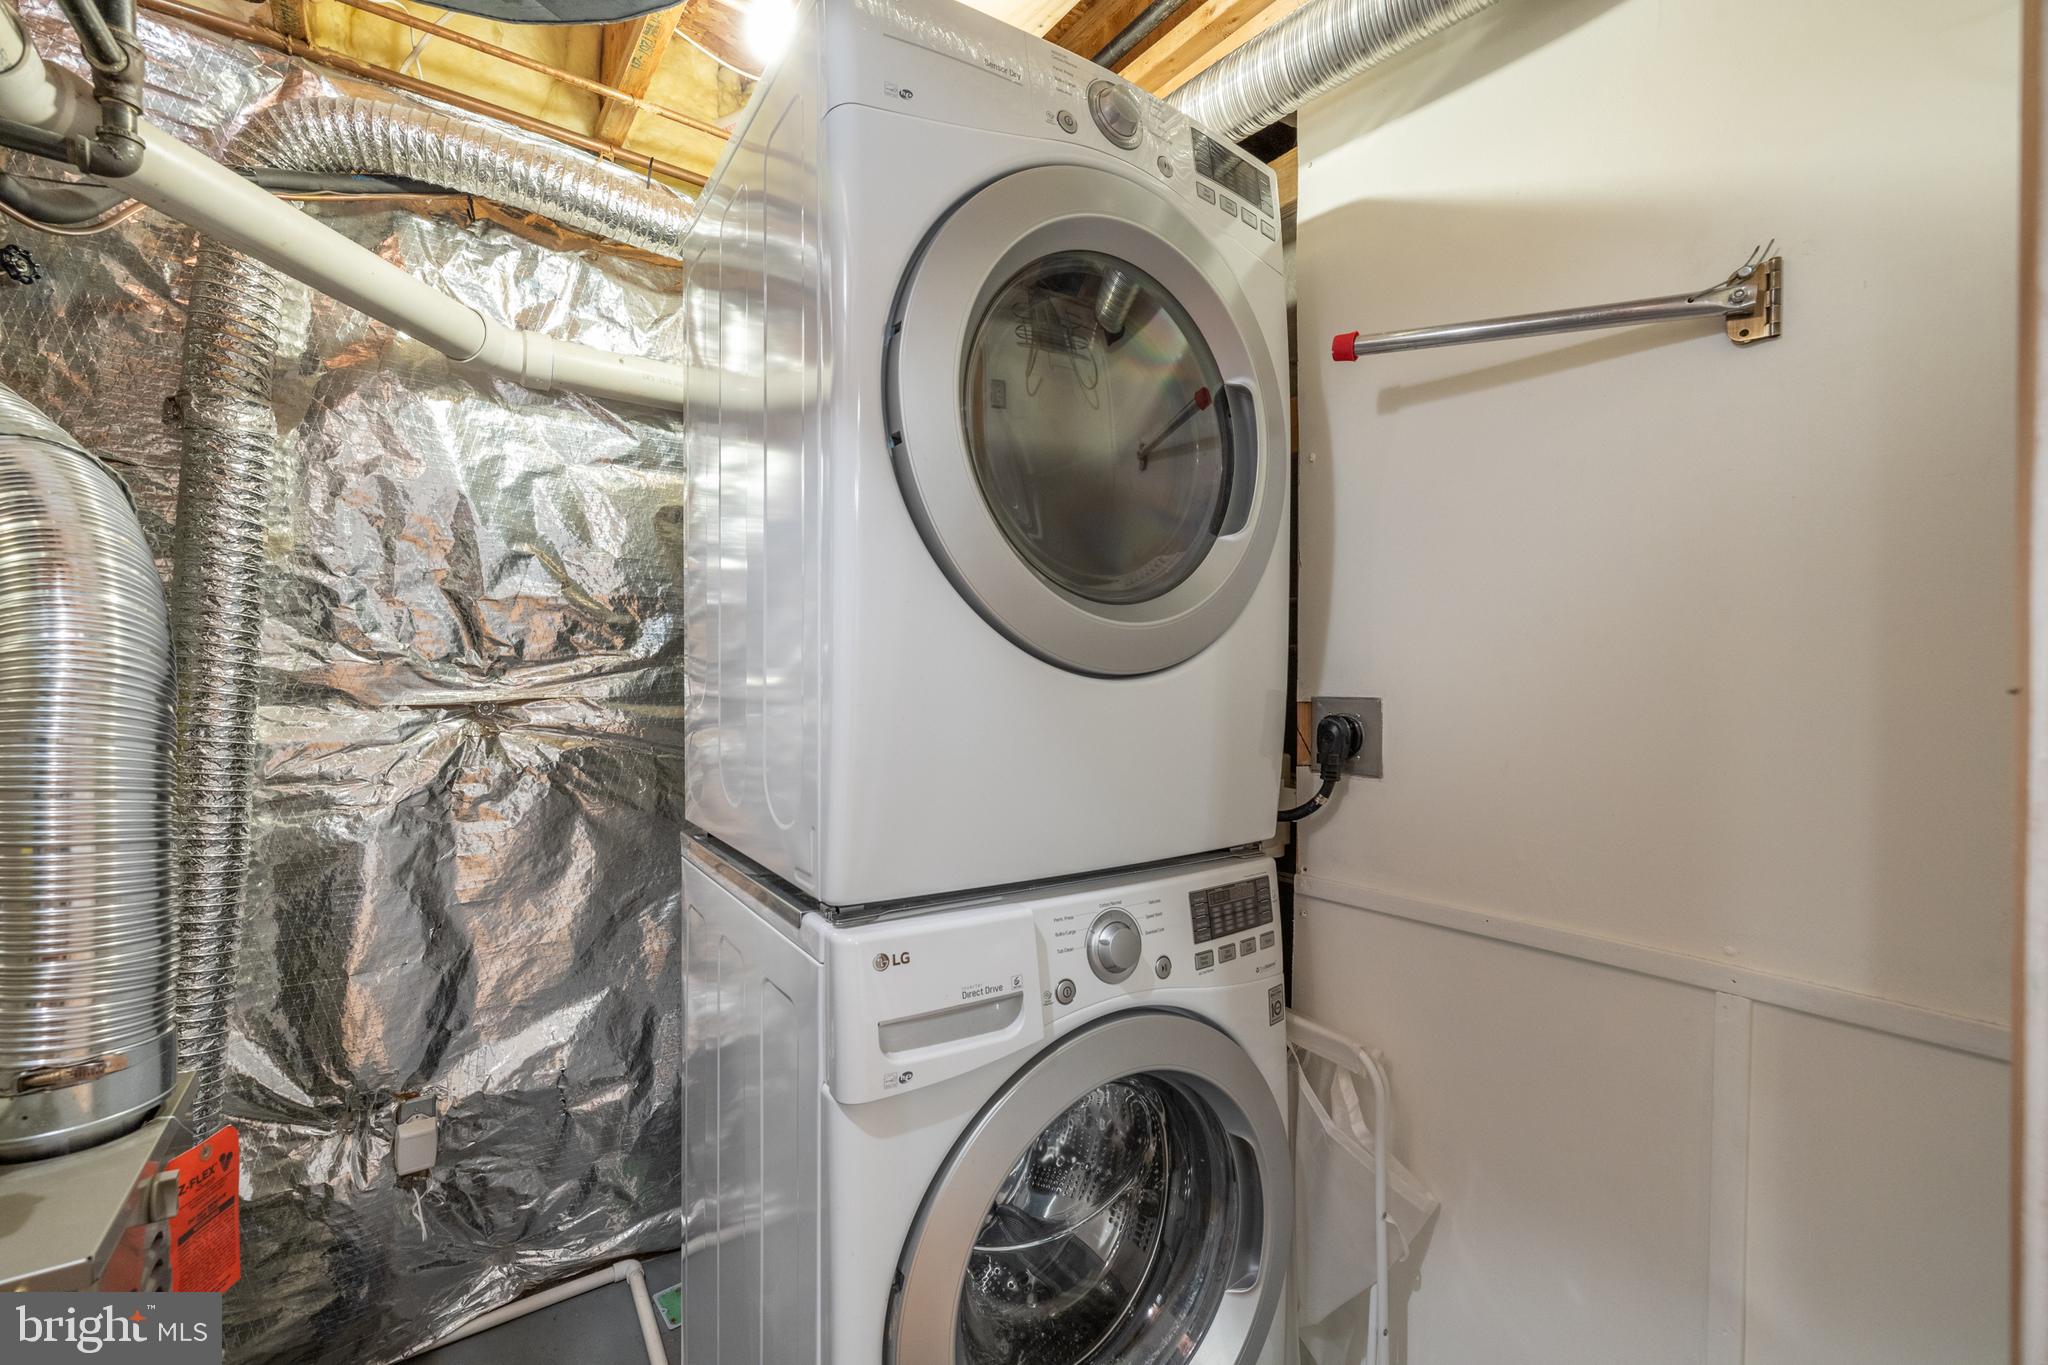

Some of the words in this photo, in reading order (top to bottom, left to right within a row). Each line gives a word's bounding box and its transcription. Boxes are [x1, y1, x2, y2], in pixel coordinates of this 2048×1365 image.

[1009, 68, 1022, 80] Dry
[892, 952, 911, 966] LG
[962, 988, 984, 1000] Direct
[985, 984, 1004, 995] Drive
